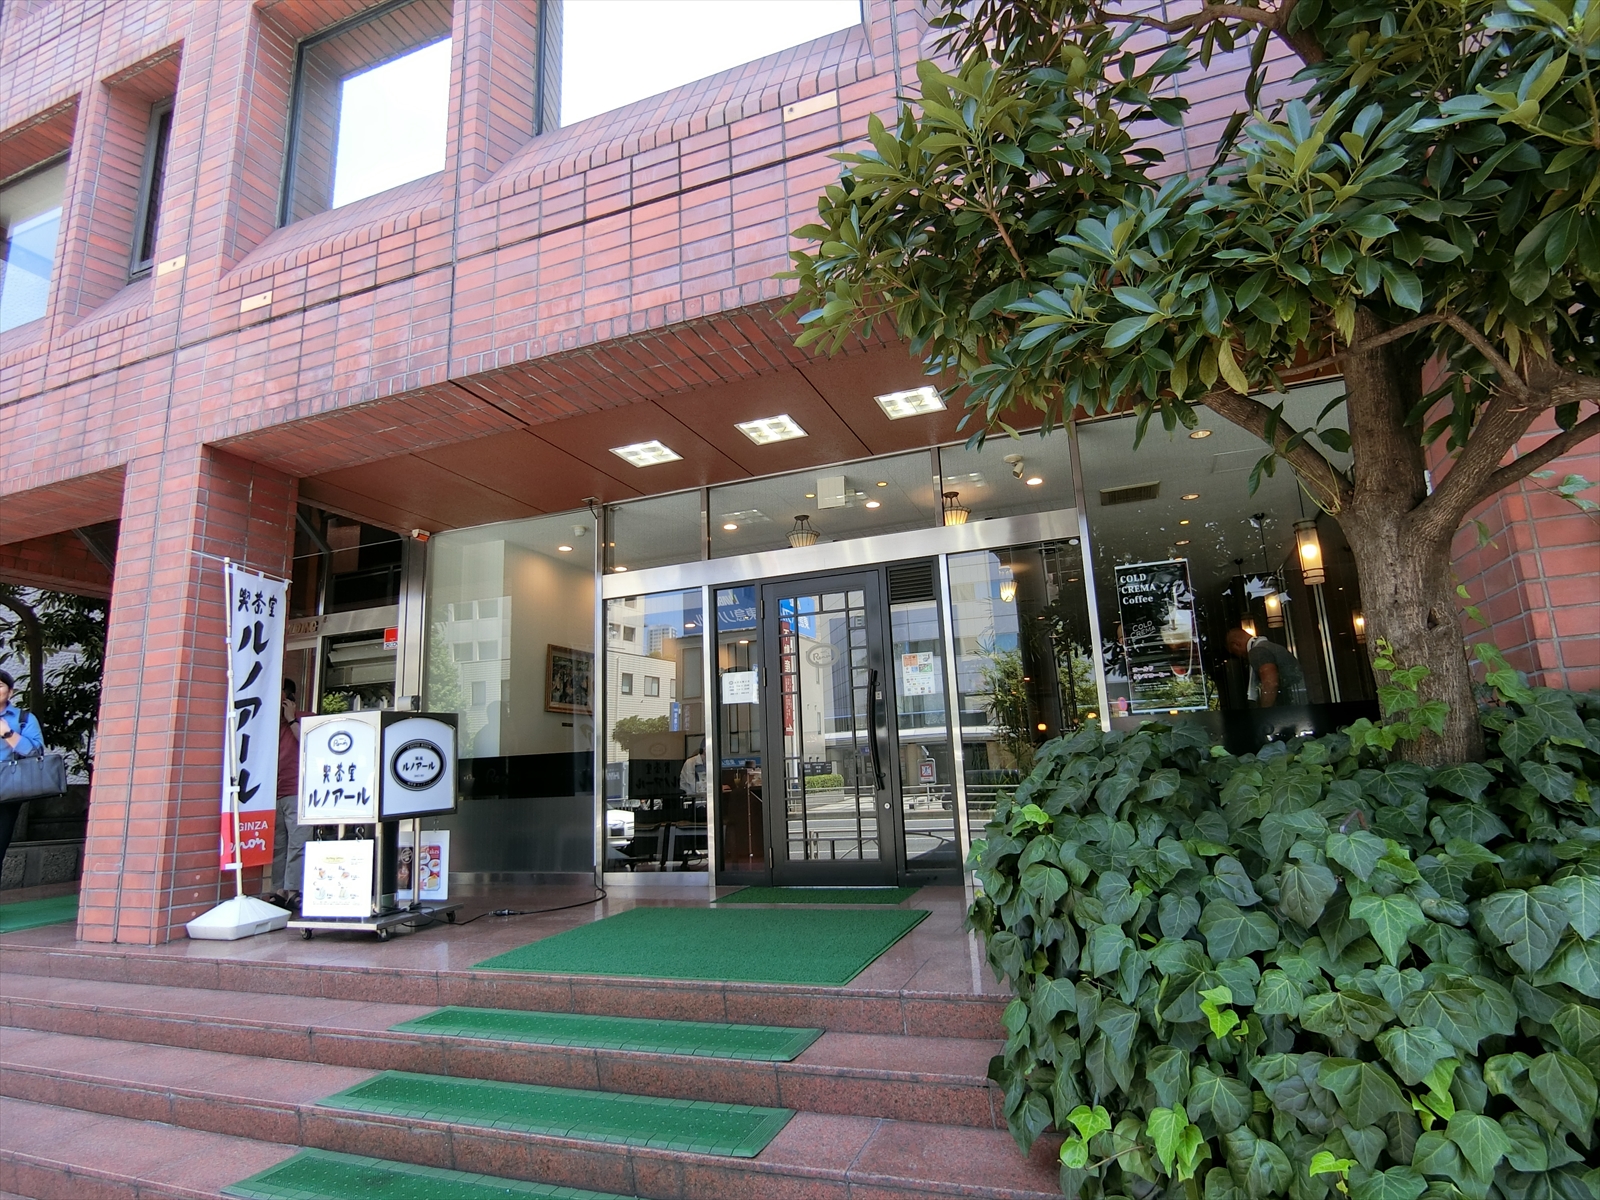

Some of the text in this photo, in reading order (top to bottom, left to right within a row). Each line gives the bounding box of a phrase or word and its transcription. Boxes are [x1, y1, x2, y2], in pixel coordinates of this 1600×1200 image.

[1120, 573, 1147, 584] COLD
[1121, 583, 1157, 595] CREMA
[238, 587, 278, 618] 喫茶室
[1122, 594, 1154, 605] Coffee
[1132, 620, 1153, 632] COLD
[232, 620, 270, 804] ルノアール
[323, 761, 357, 784] 喫茶室
[402, 761, 436, 772] ルノアール
[308, 786, 371, 808] ルノアール
[239, 820, 269, 832] GINZA
